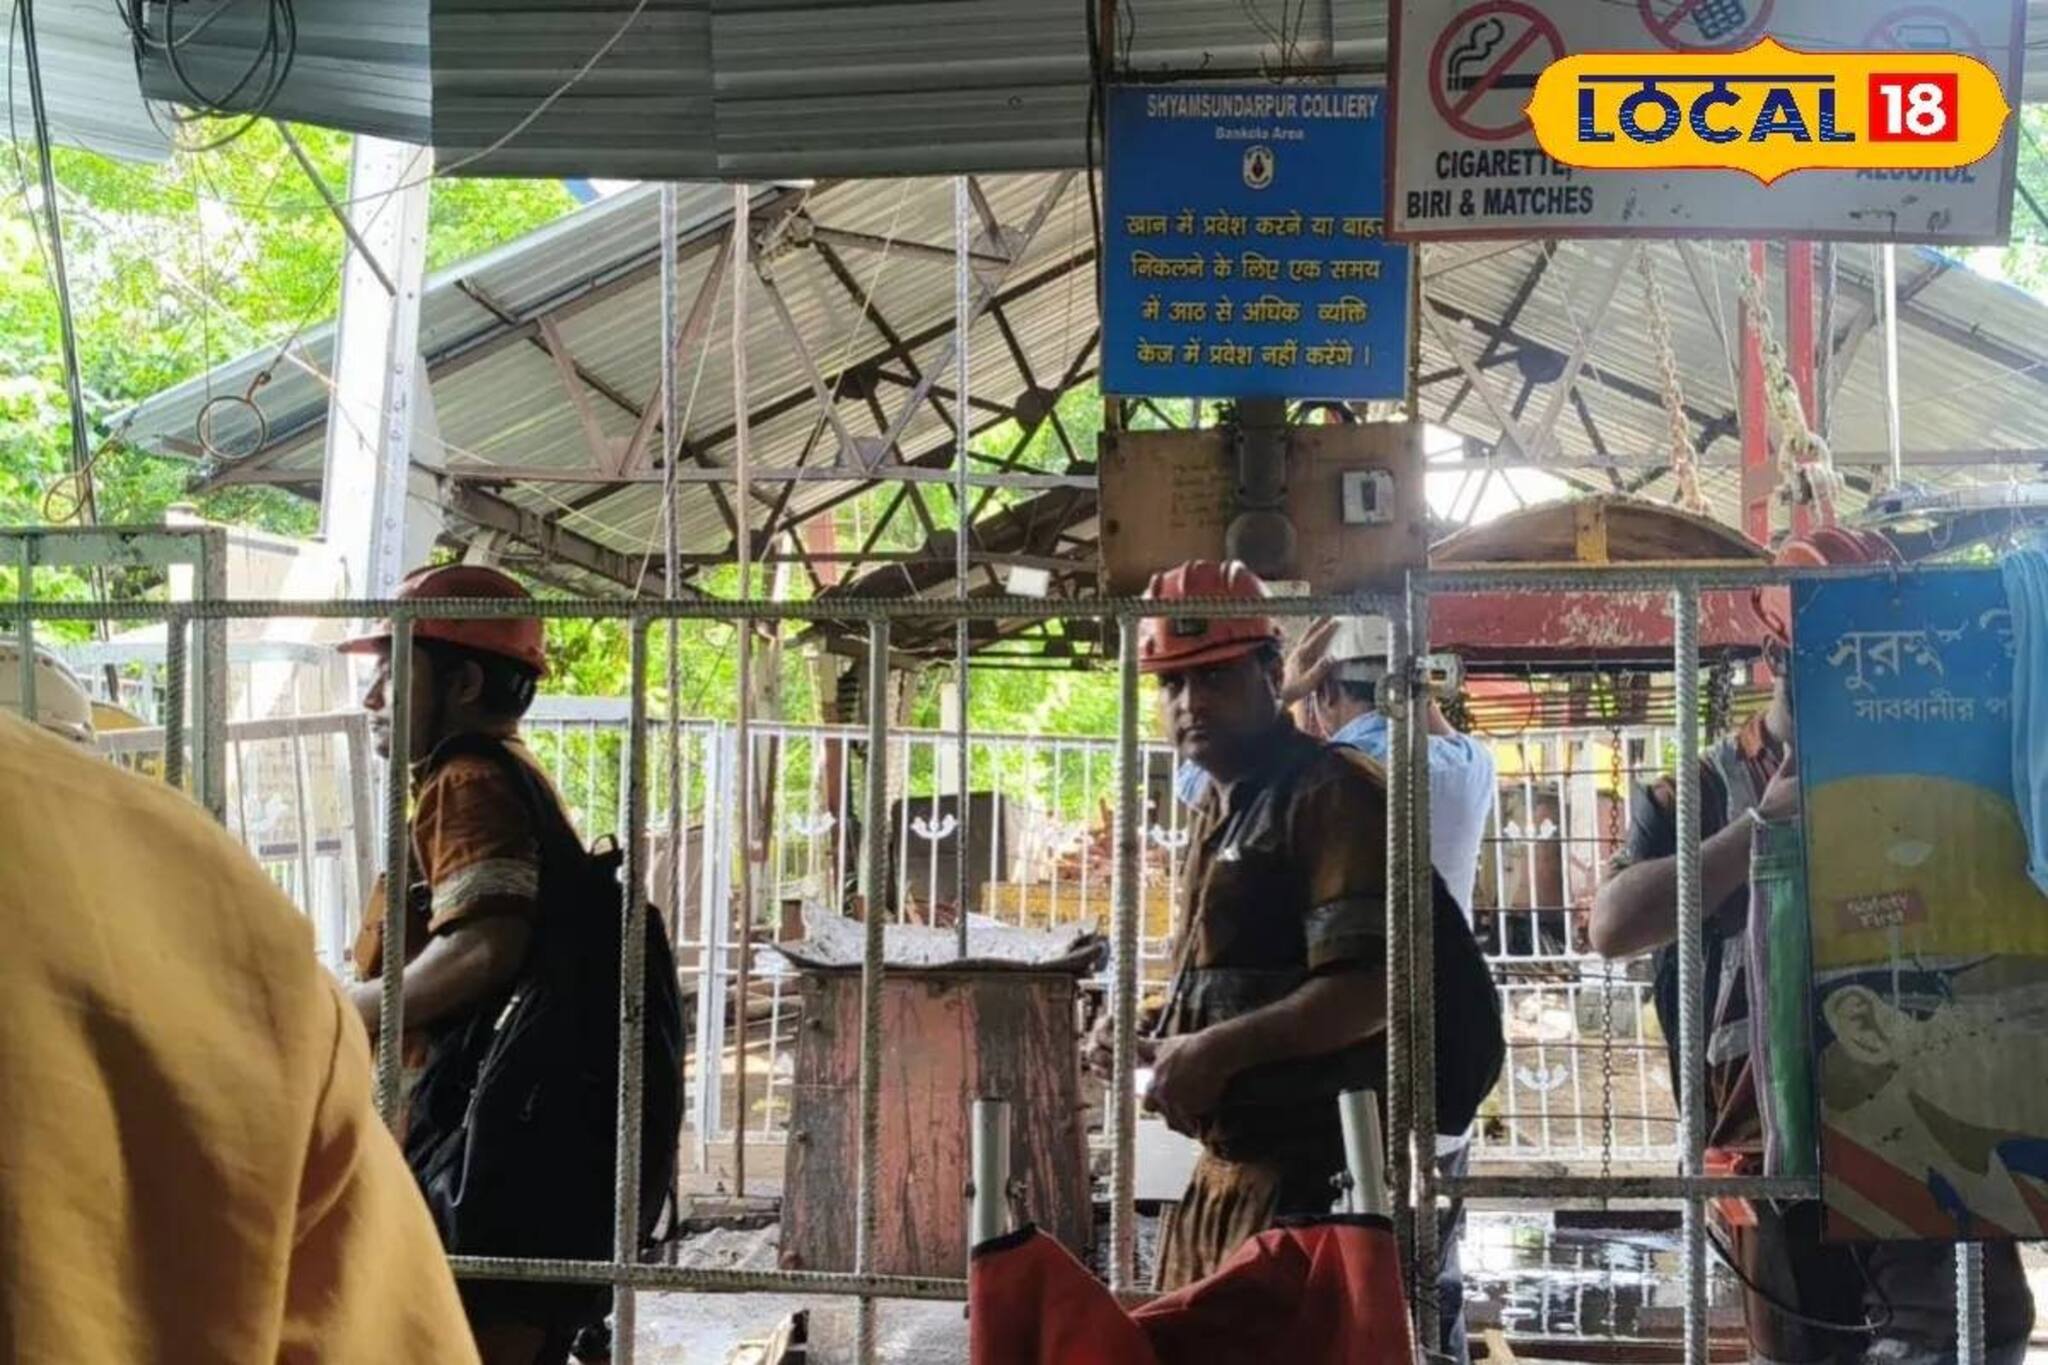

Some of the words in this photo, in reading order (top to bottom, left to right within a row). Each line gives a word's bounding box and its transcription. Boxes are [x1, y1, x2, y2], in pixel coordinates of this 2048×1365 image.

[1147, 94, 1297, 118] SHYAMSUNDARPUR
[1301, 94, 1379, 118] COLLIERY
[1272, 126, 1304, 140] Area
[1407, 190, 1451, 219] BIRI
[1459, 189, 1475, 216] &
[1483, 186, 1594, 216] MATCHES
[1127, 215, 1167, 235] खान
[1176, 208, 1195, 235] में
[1203, 208, 1248, 236] प्रवेश
[1256, 208, 1302, 236] करने
[1311, 217, 1335, 236] या
[1133, 250, 1204, 277] निकलने
[1213, 251, 1234, 277] के
[1242, 250, 1280, 280] लिए
[1289, 260, 1322, 281] एक
[1330, 260, 1382, 279] समय
[1141, 293, 1161, 320] में
[1168, 302, 1207, 321] आठ
[1214, 294, 1234, 320] से
[1242, 294, 1301, 321] अधिक
[1317, 294, 1368, 322] व्यक्ति
[1136, 336, 1174, 363] केज
[1182, 337, 1200, 363] में
[1209, 338, 1253, 364] प्रवेश
[1261, 338, 1299, 366] नहीं
[1305, 338, 1353, 365] करेंगे
